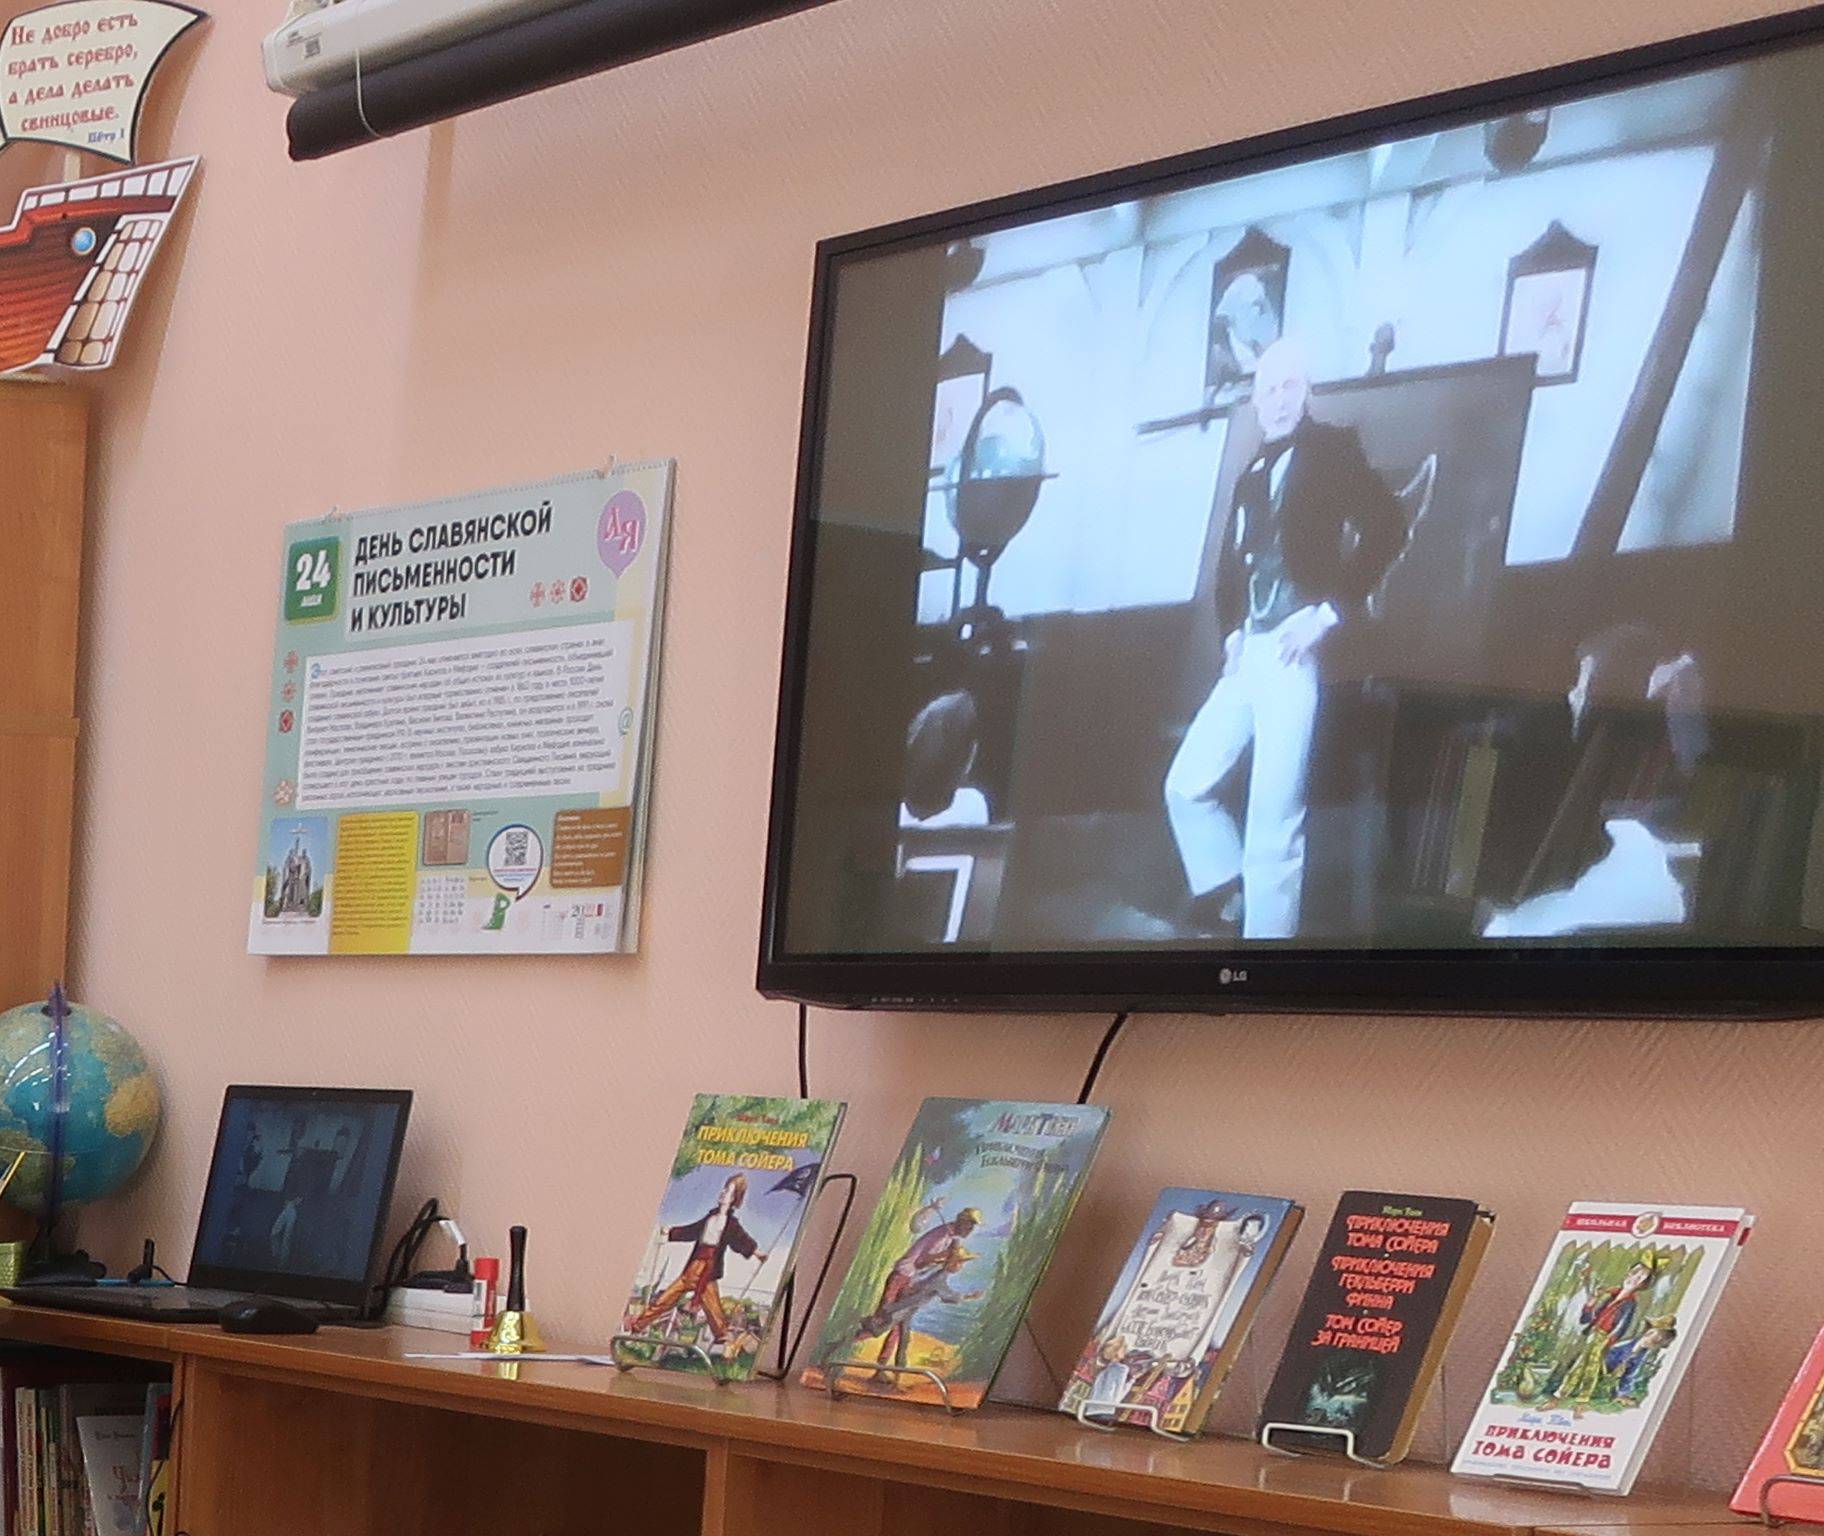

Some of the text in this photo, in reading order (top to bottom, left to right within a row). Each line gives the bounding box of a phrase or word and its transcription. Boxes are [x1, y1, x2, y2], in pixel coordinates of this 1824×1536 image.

[355, 500, 553, 566] ДЕНЬ СЛАВЯНСКОЙ
[296, 549, 332, 592] 24
[353, 550, 517, 597] ПИСЬМЕННОСТИ
[351, 593, 467, 632] И КУЛЬТУРЫ
[1233, 970, 1248, 981] LG
[697, 1125, 809, 1147] ПРИКЛЮЧЕНИЯ
[698, 1149, 794, 1171] ТОМА СОЙЕРА
[1346, 1215, 1451, 1237] ПРИКЛЮЧЕНИЯ
[1347, 1232, 1439, 1254] ТОМА СОЙЕРА
[1331, 1255, 1437, 1278] ПРИКЛЮЧЕНИЯ
[1338, 1273, 1417, 1294] ГЕКЛЬБЕРРИ
[1345, 1291, 1395, 1310] ФИННА
[1326, 1314, 1403, 1336] ТОМ СОЙЕР
[1310, 1330, 1401, 1354] ЗА ГРАНИЦЕЙ
[1484, 1424, 1617, 1449] ПРИКЛЮЧЕНИЯ
[1472, 1440, 1525, 1460] ТОМА
[1533, 1447, 1612, 1470] СОЙЕРА
